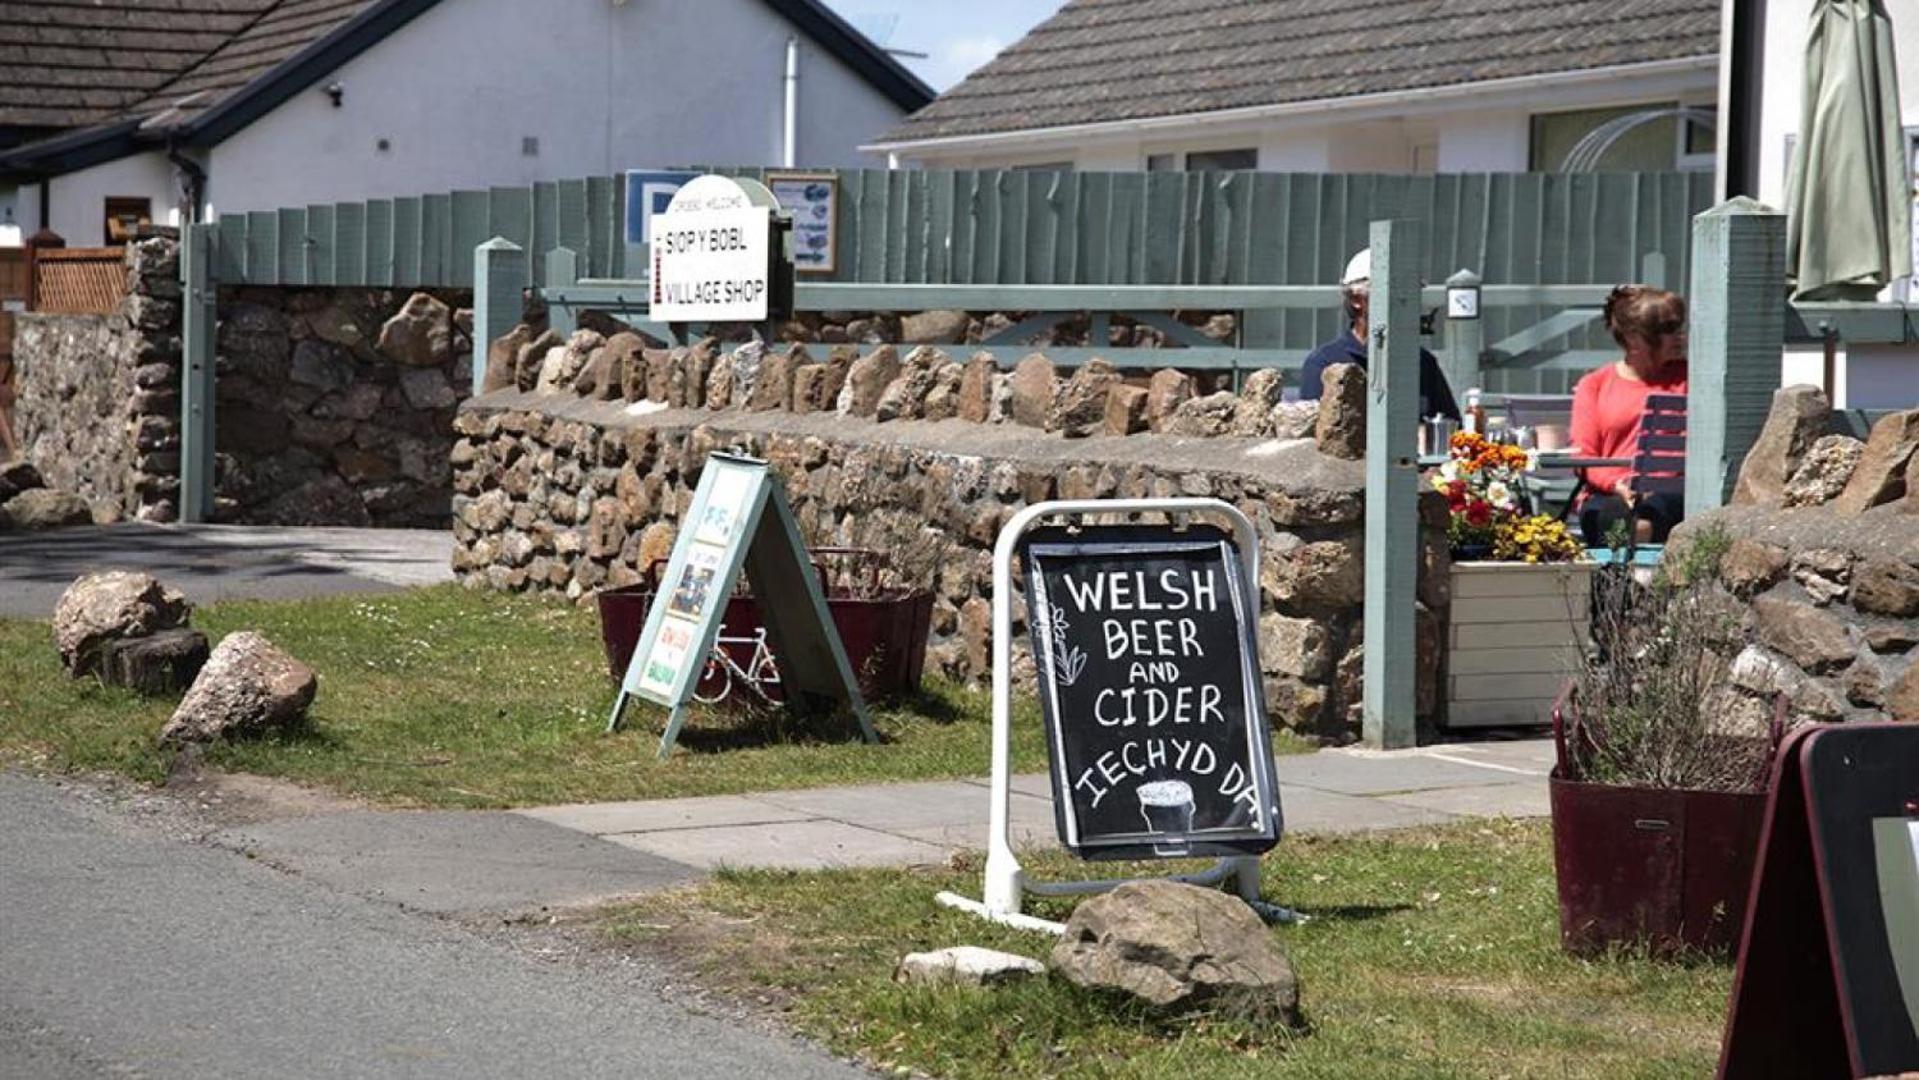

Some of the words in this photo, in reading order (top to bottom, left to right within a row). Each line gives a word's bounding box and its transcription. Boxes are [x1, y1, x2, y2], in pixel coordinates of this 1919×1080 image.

[698, 230, 707, 252] Y
[710, 227, 748, 252] BOBL
[665, 280, 720, 304] VILLAGE
[724, 279, 764, 303] SHOP
[1063, 569, 1217, 613] WELSH
[1103, 617, 1205, 660] BEER
[1129, 661, 1179, 684] AND
[1094, 684, 1225, 727] CIDER
